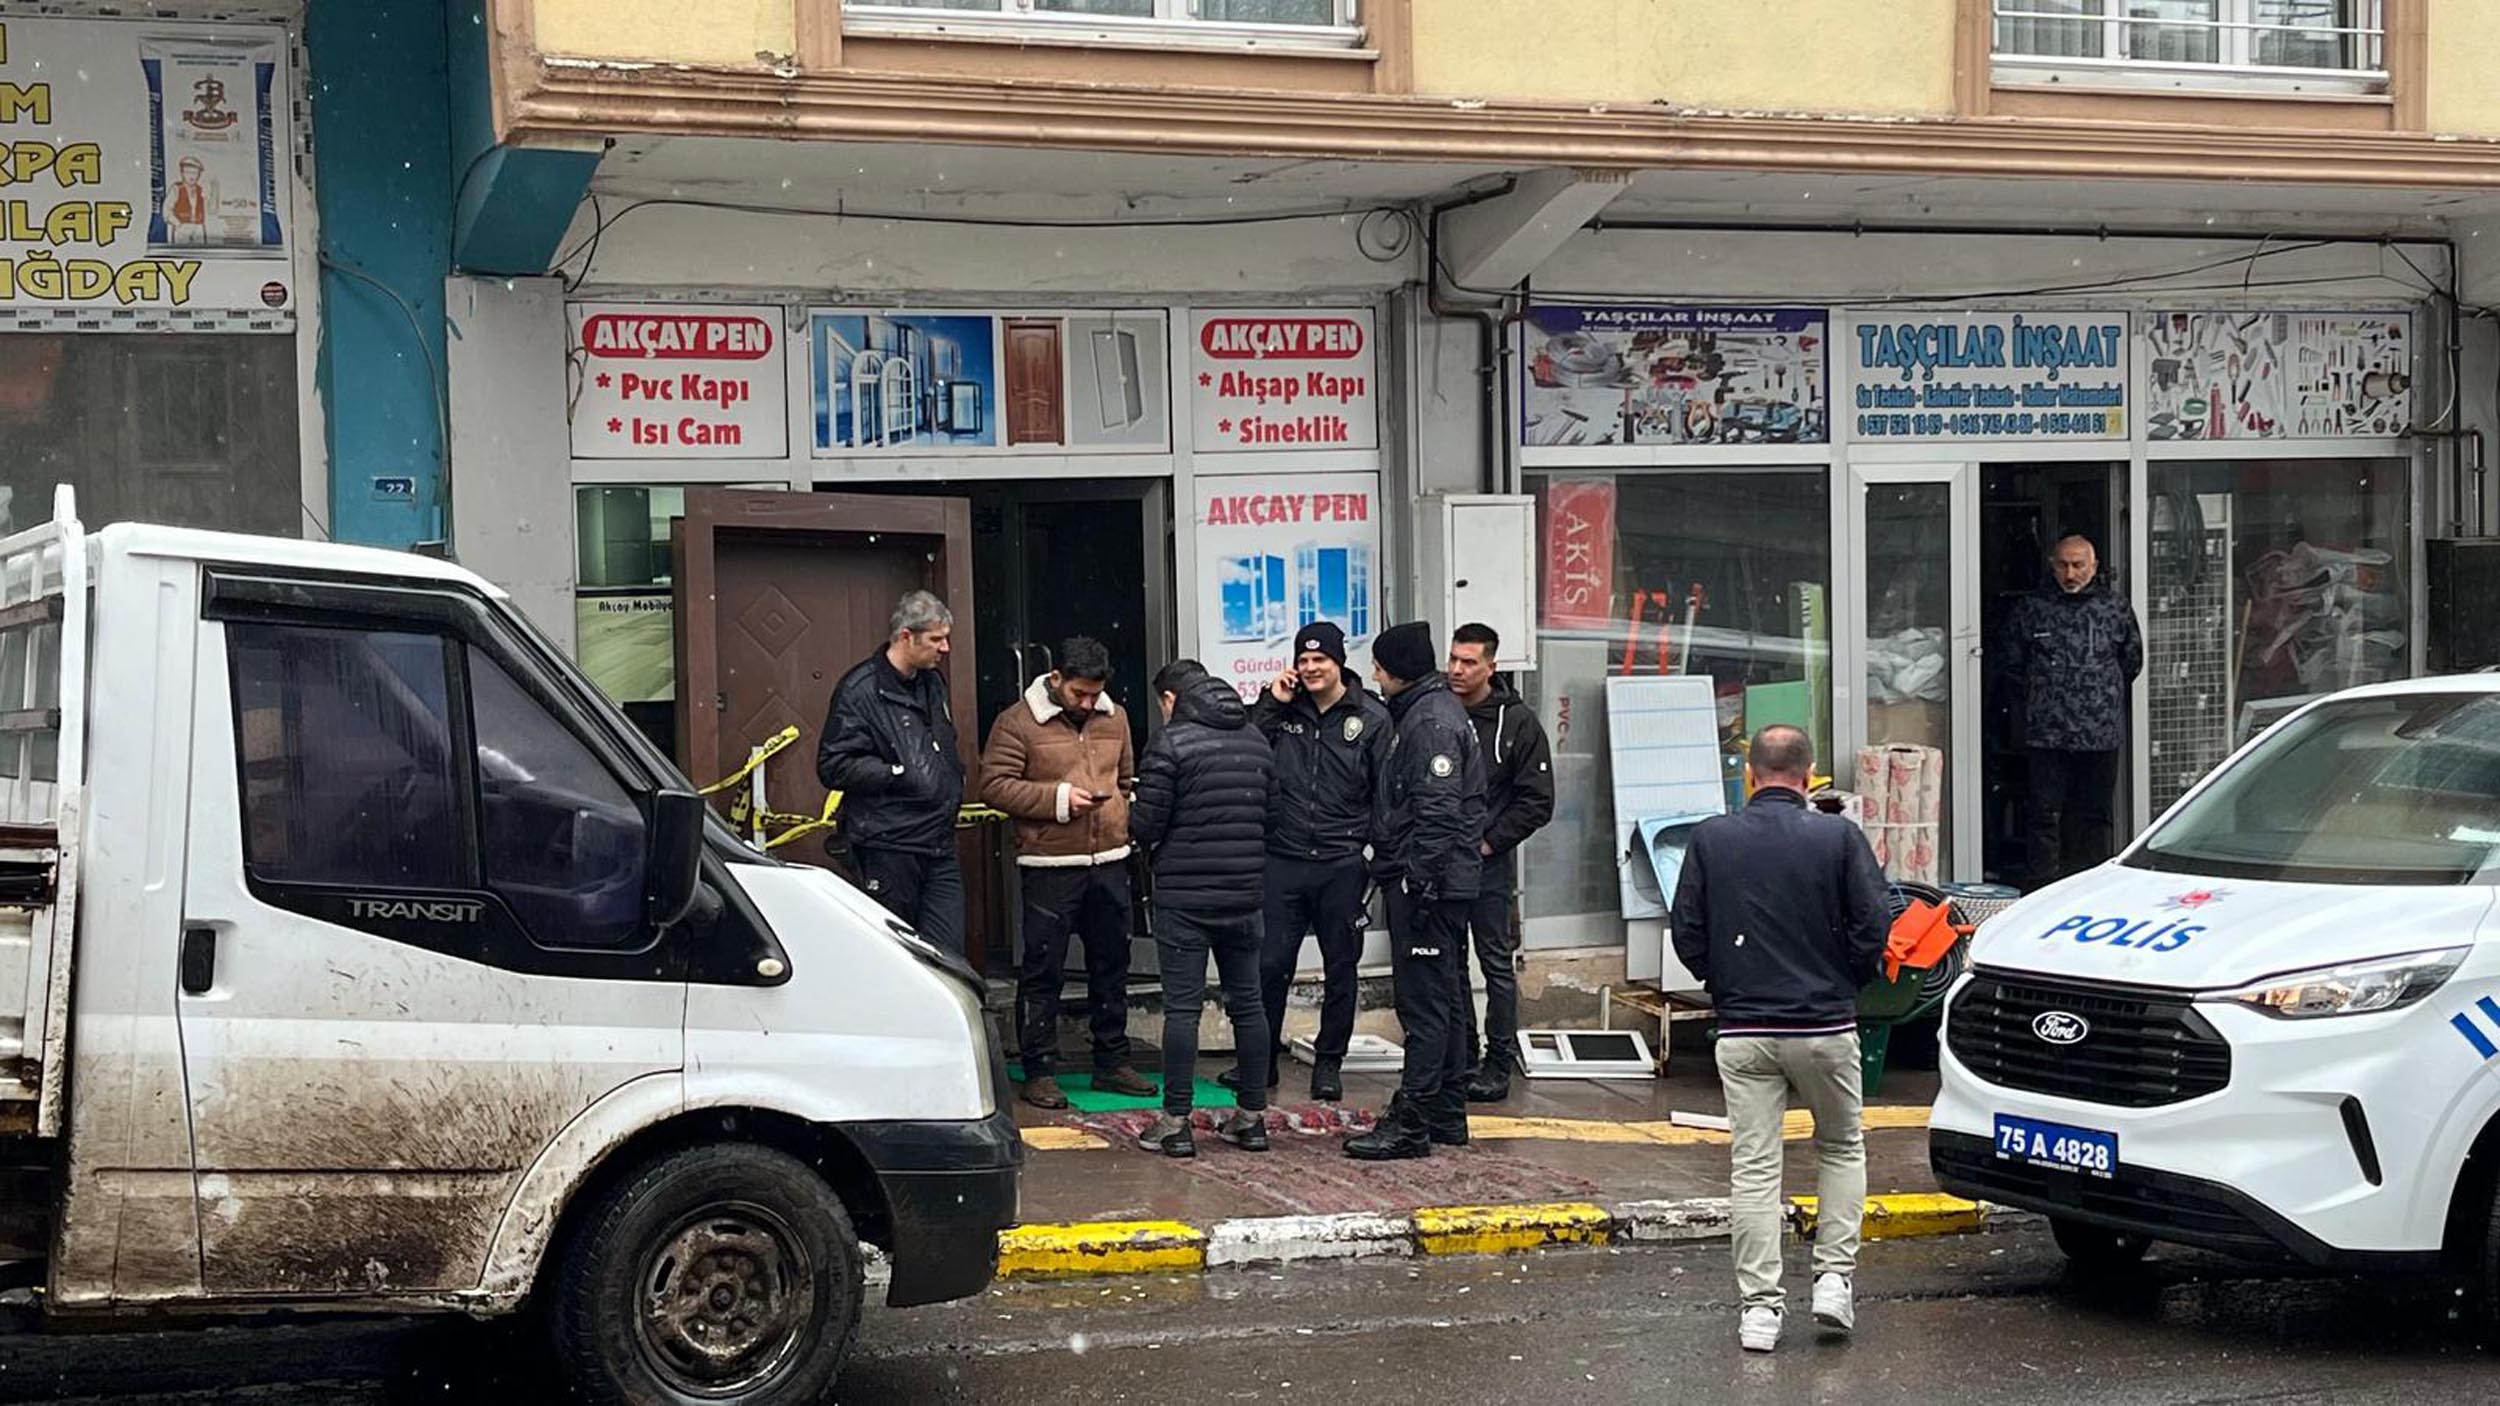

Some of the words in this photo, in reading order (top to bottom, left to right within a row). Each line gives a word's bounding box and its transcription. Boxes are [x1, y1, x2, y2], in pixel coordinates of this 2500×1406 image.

[1581, 311, 1689, 325] TAŞÇILAR
[1696, 310, 1776, 325] İNŞAAT
[594, 320, 699, 358] AKÇAY
[706, 322, 766, 351] PEN
[1211, 324, 1301, 358] AKÇAY
[1306, 324, 1358, 351] PEN
[1857, 324, 2006, 382] TAŞÇILAR
[2012, 314, 2121, 382] İNŞAAT
[621, 373, 673, 400] Pvc
[681, 374, 748, 409] Kapı
[1219, 371, 1299, 405] Ahşap
[1307, 372, 1365, 405] Kapı
[633, 418, 668, 444] Isı
[678, 417, 741, 444] Cam
[1239, 416, 1348, 443] Sineklik
[1207, 494, 1305, 525] AKÇAY
[1313, 493, 1368, 522] PEN
[1234, 655, 1287, 674] Gürdal
[1557, 697, 1571, 735] PVC
[348, 899, 484, 923] TRANSIT
[2038, 915, 2208, 952] POLİS
[2040, 1014, 2079, 1040] Ford
[1999, 1124, 2026, 1153] 75
[2031, 1132, 2048, 1158] A
[2052, 1136, 2109, 1171] 4828
